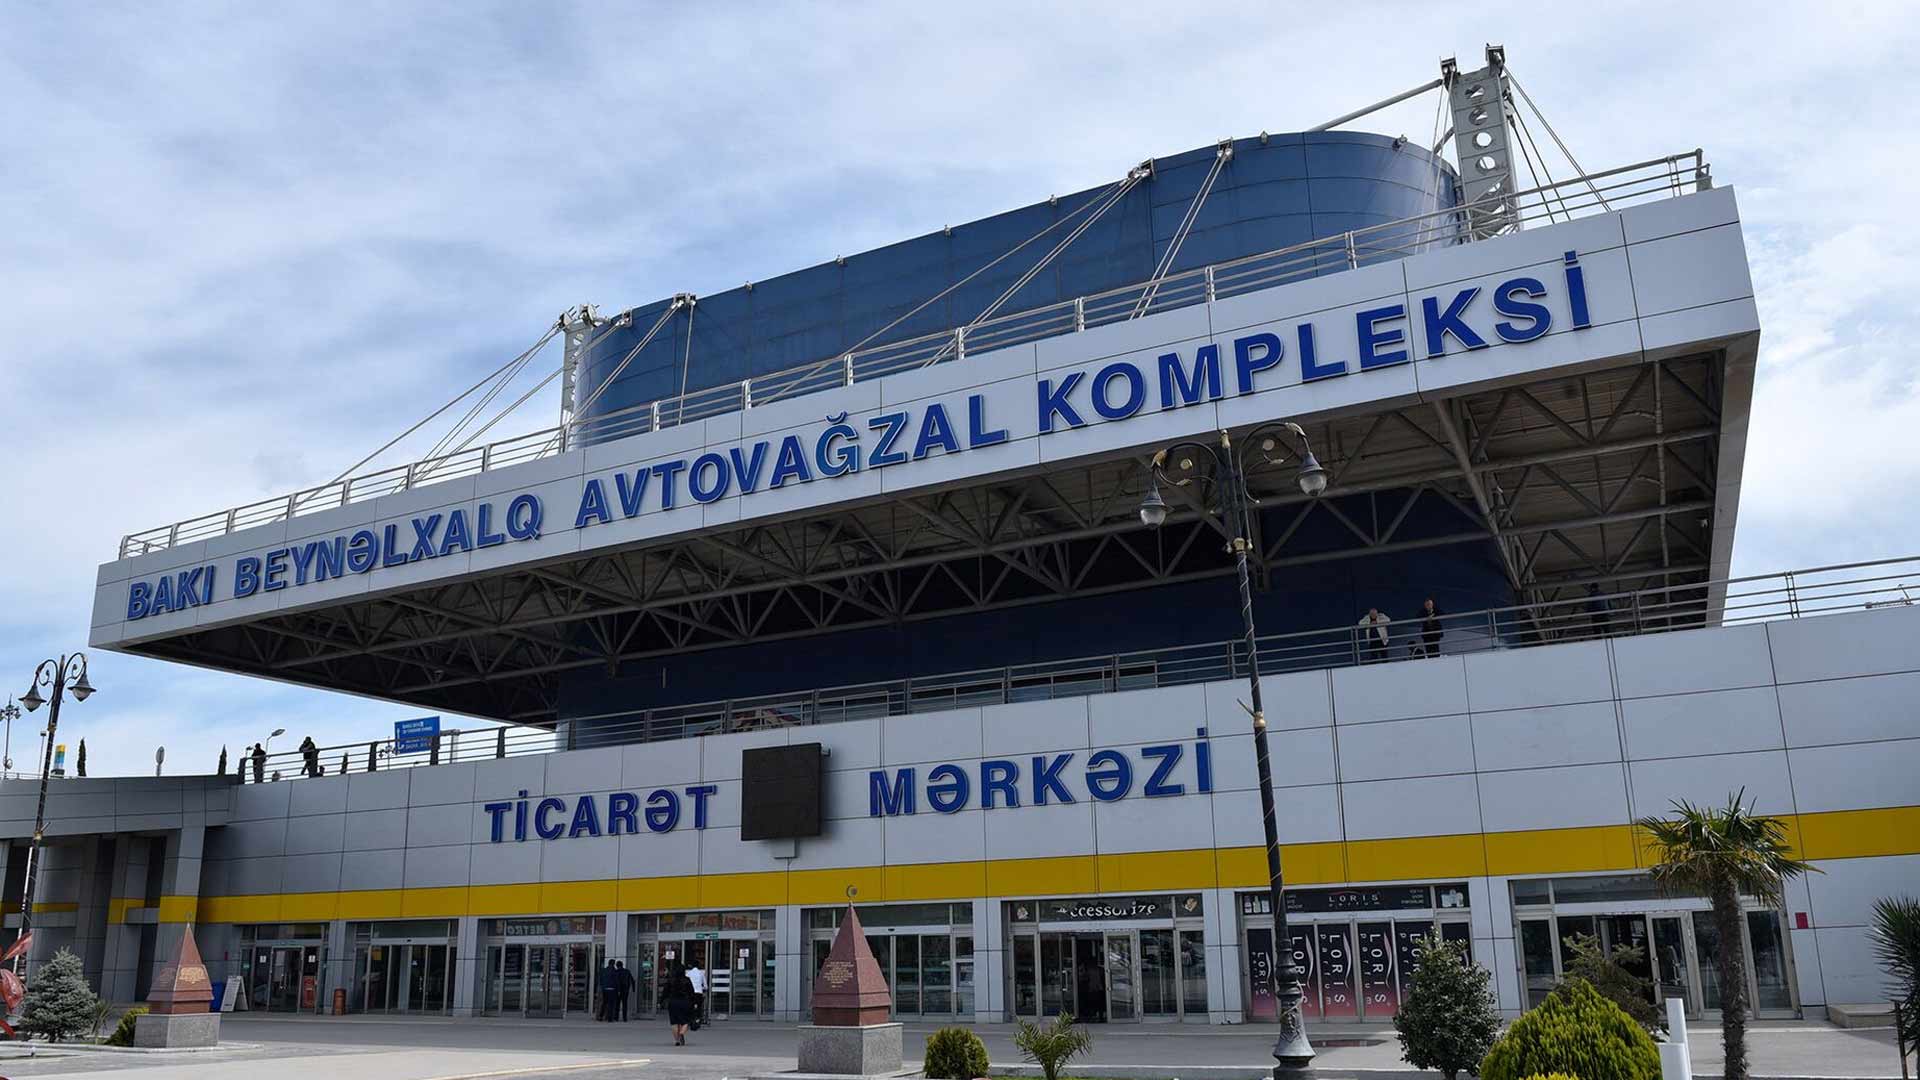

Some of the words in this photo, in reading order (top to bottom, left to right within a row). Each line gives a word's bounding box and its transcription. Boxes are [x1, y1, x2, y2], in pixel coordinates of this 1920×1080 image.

[127, 565, 215, 620] BAKI
[234, 494, 543, 599] BEYNƏLXALQ
[574, 394, 1008, 529] AVTOVAĞZAL
[1037, 250, 1592, 433] KOMPLEKSİ
[485, 784, 717, 843] TİCARƏT
[869, 727, 1214, 818] MƏRKƏZİ
[1328, 894, 1378, 903] LORIS
[1329, 934, 1346, 1003] LORIS
[1369, 934, 1387, 1003] LORIS
